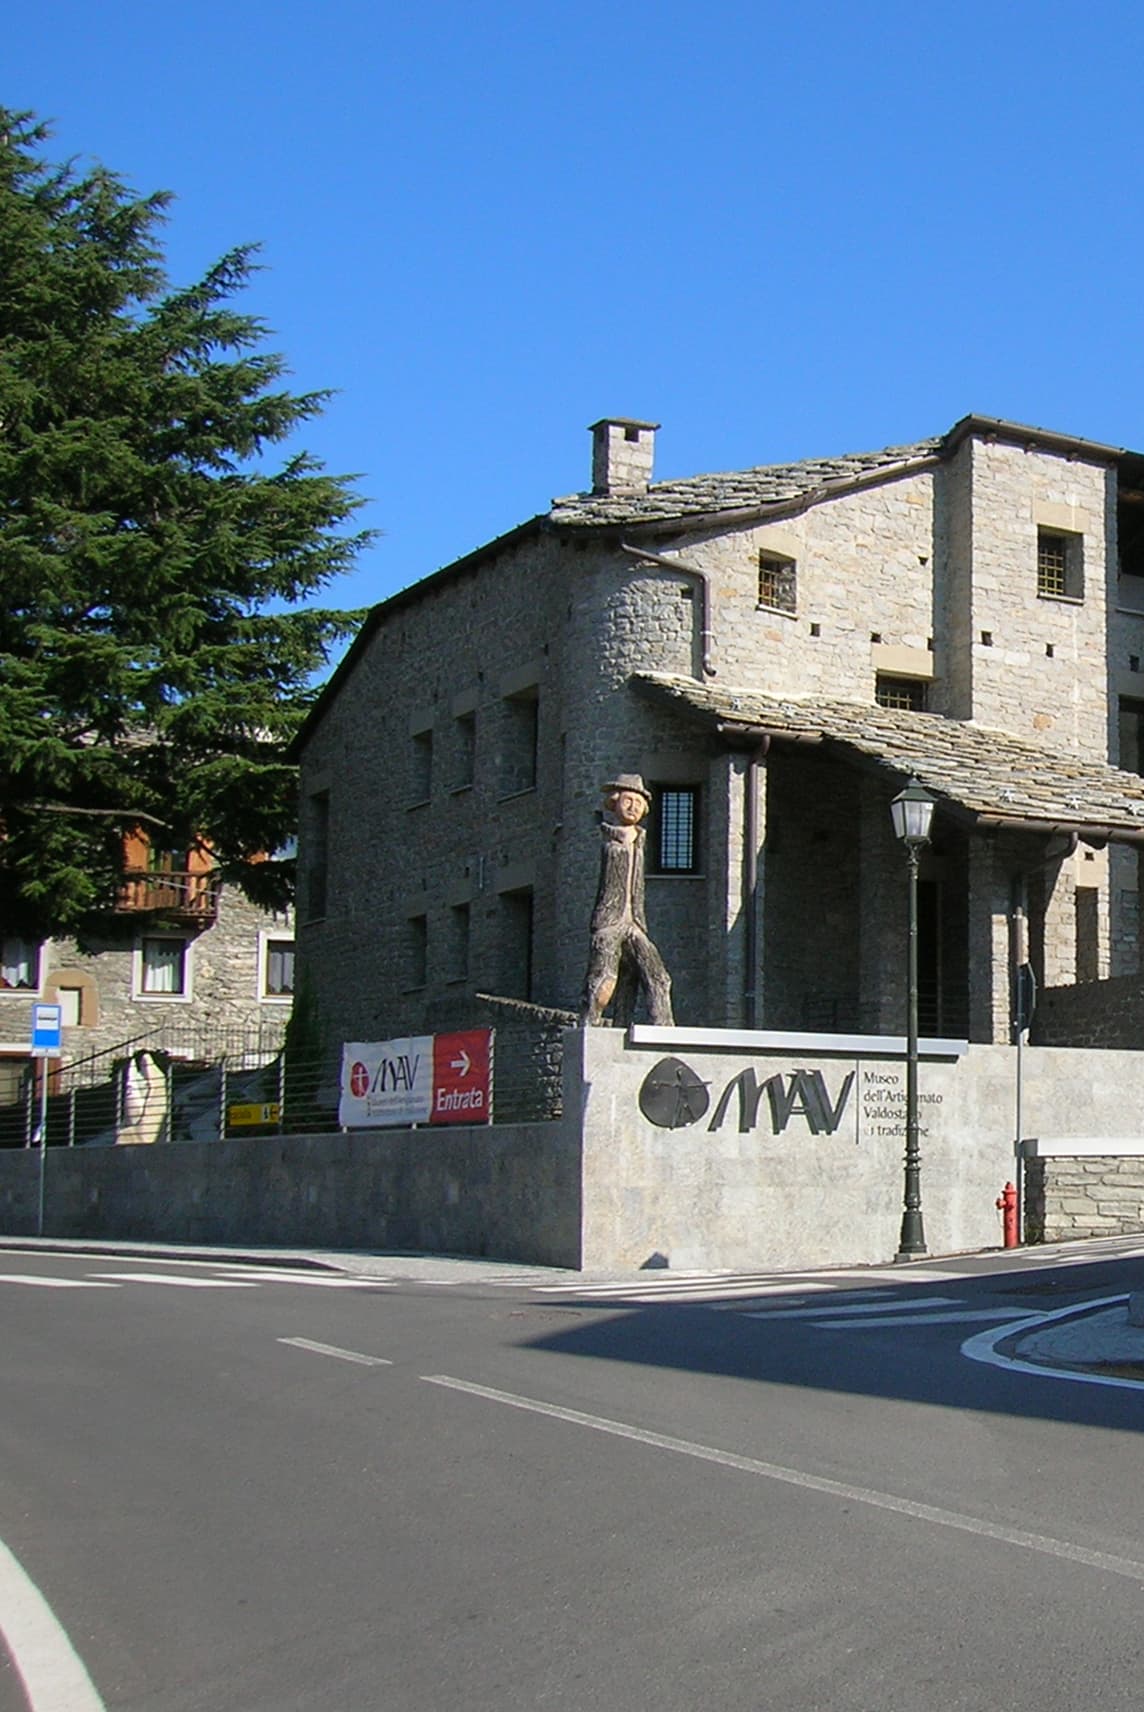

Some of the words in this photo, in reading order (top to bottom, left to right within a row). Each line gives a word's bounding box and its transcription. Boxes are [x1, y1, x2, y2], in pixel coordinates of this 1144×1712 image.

[371, 1054, 420, 1093] MAV
[864, 1071, 899, 1084] Museo
[437, 1086, 483, 1111] Entrata
[707, 1067, 856, 1135] MAV
[863, 1089, 943, 1104] dell'Artignato
[863, 1106, 922, 1120] Valdostao
[877, 1124, 929, 1137] tradizne
